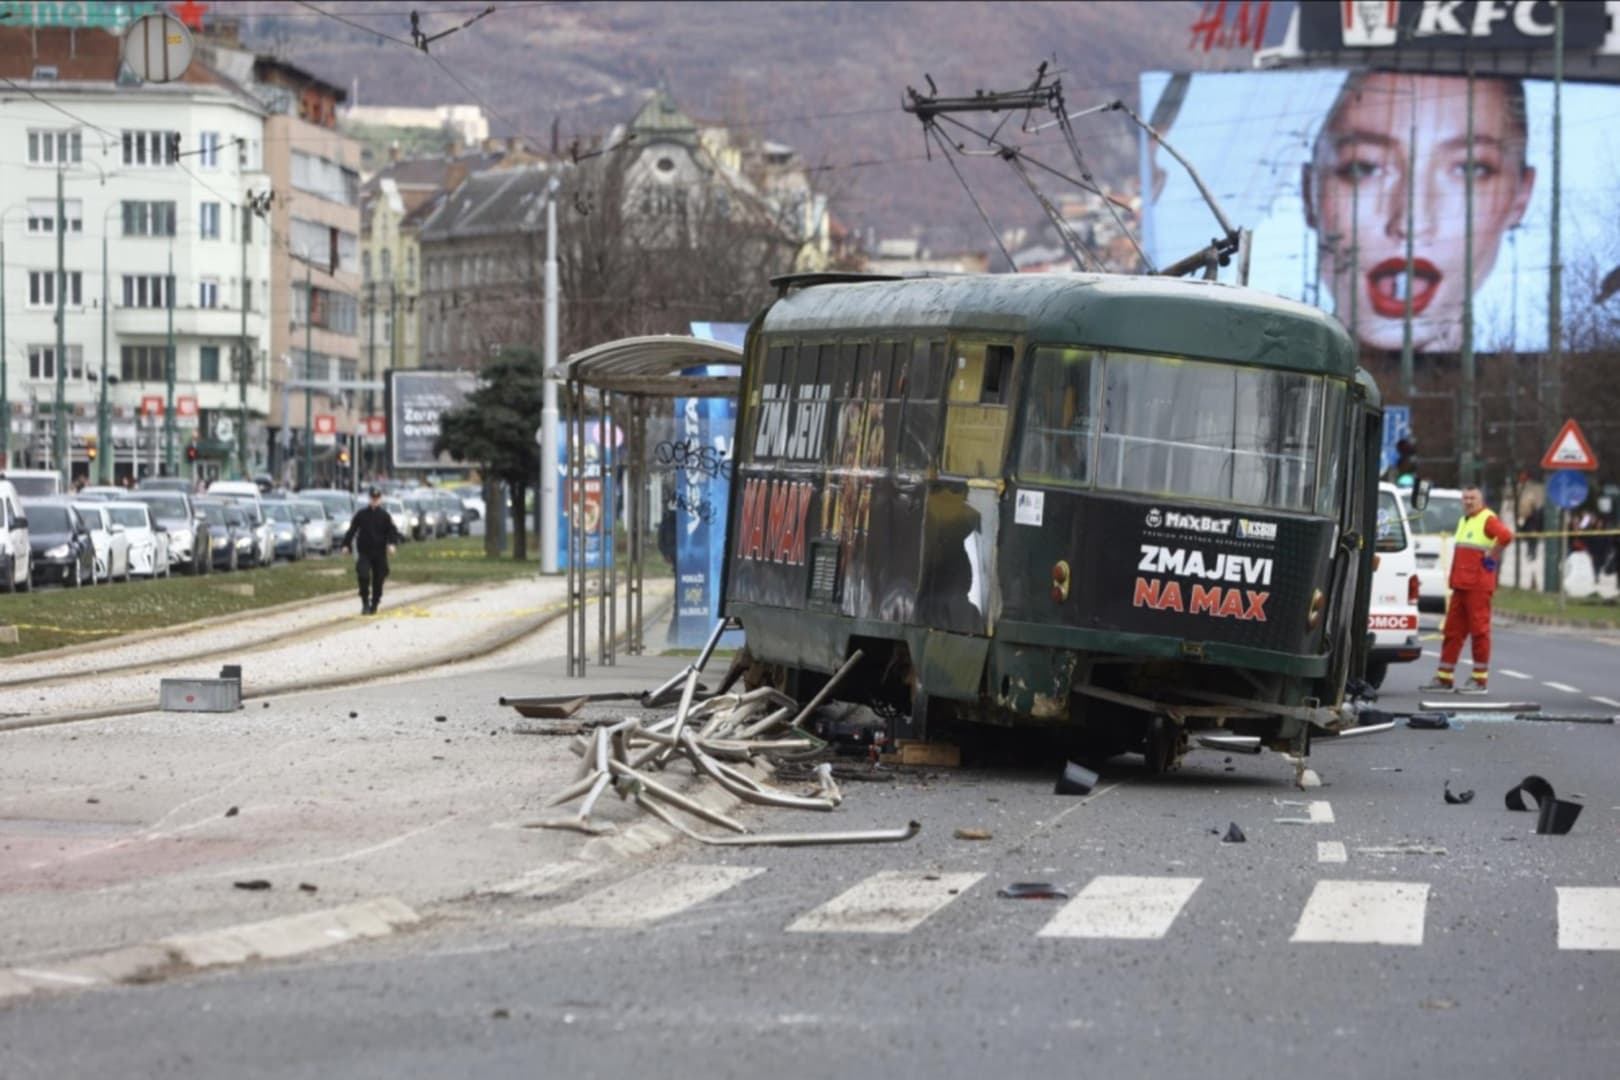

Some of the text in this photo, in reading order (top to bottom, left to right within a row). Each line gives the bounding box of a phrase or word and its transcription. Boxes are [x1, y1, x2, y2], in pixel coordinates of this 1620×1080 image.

[1413, 1, 1555, 36] KFC
[755, 384, 831, 459] ZMAJEVI
[738, 477, 814, 567] NA MAX
[1138, 544, 1273, 585] ZMAJEVI
[1132, 576, 1270, 622] NA MAX
